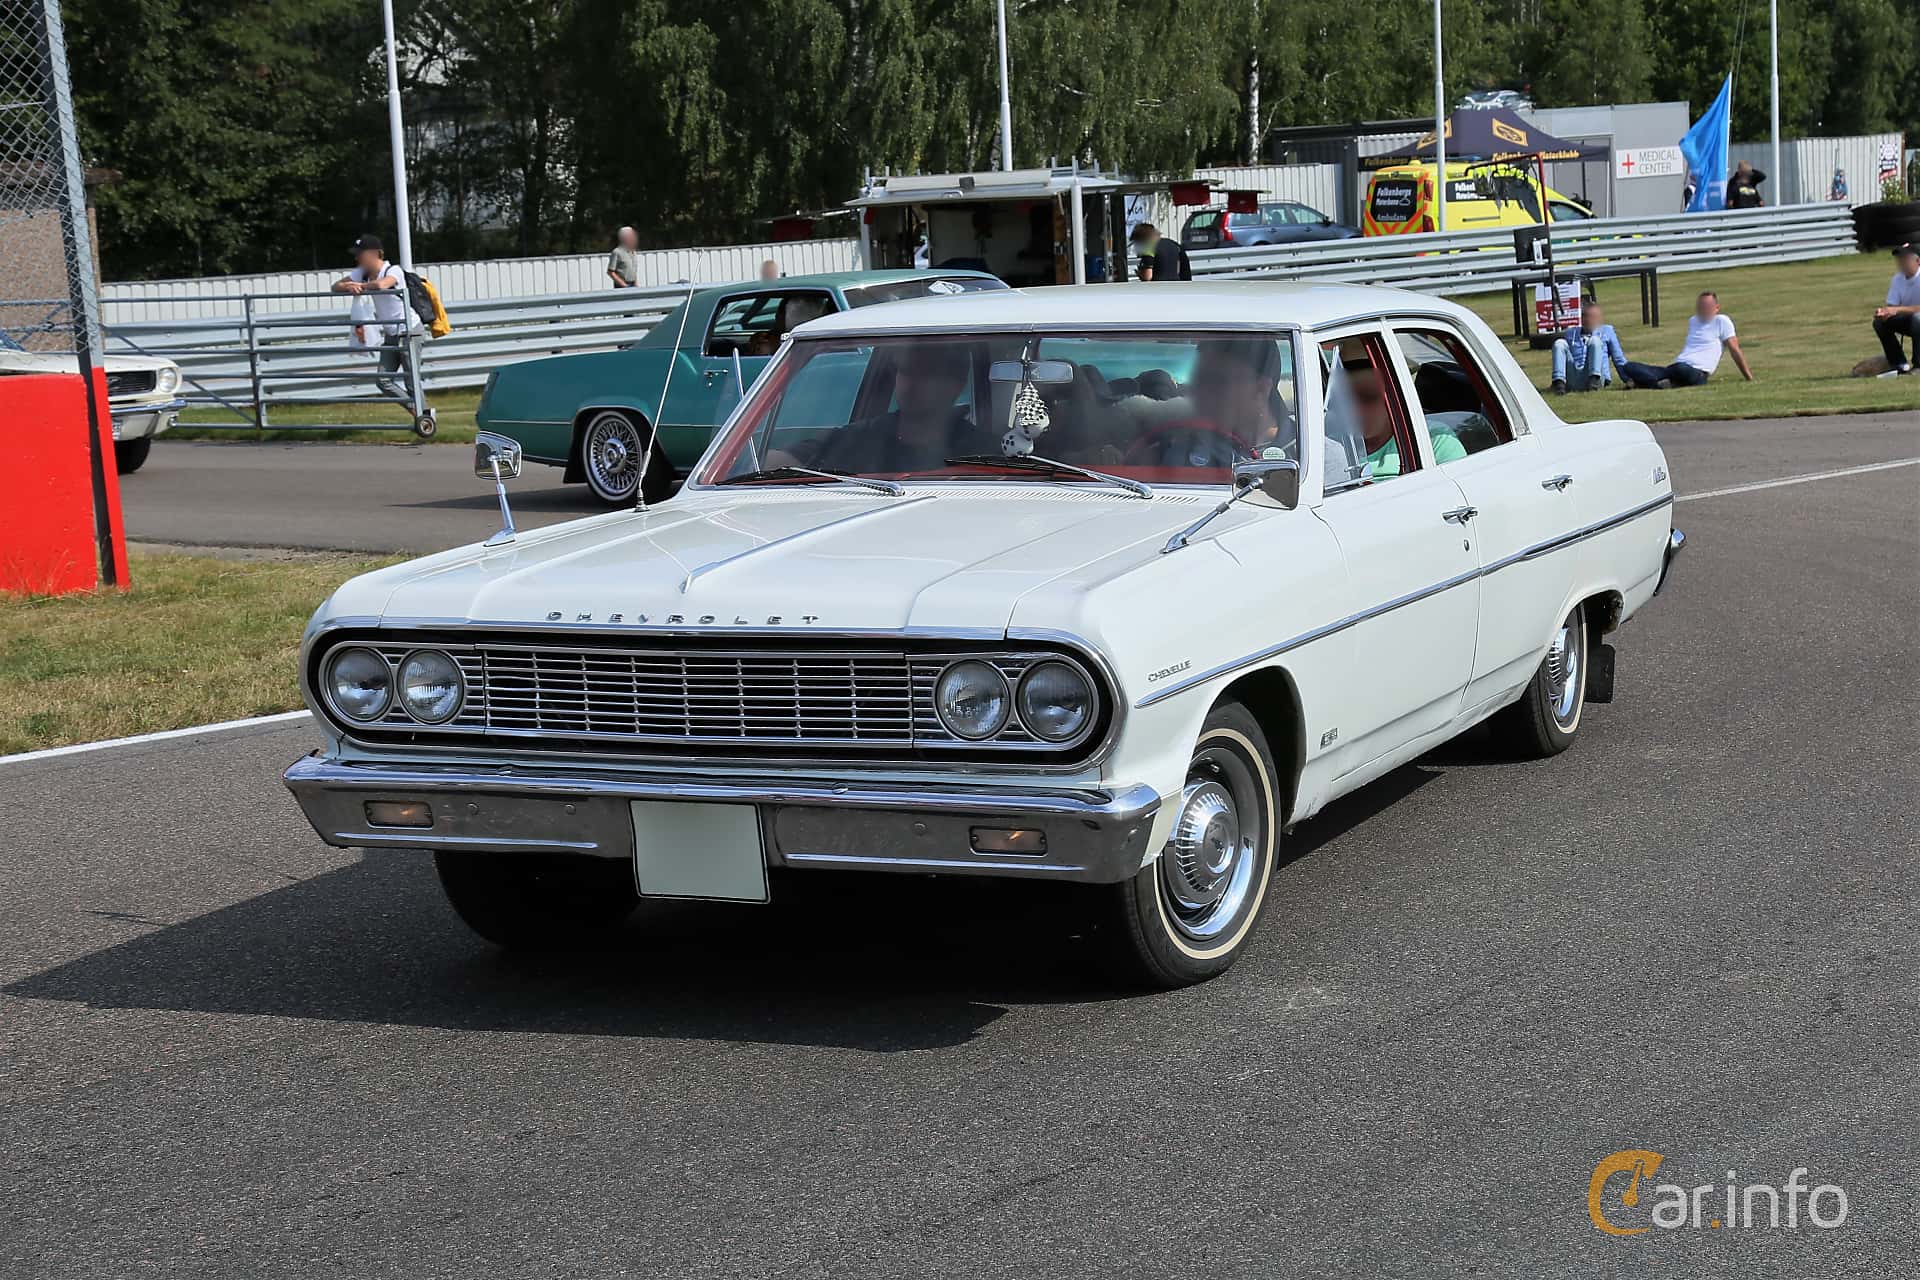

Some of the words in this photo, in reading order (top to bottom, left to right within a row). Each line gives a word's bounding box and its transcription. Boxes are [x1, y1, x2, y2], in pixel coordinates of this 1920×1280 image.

[1639, 150, 1678, 161] MEDICAL
[1639, 162, 1672, 174] CENTER
[547, 611, 819, 625] CHEVROLET
[1147, 659, 1192, 682] CHEVELLE
